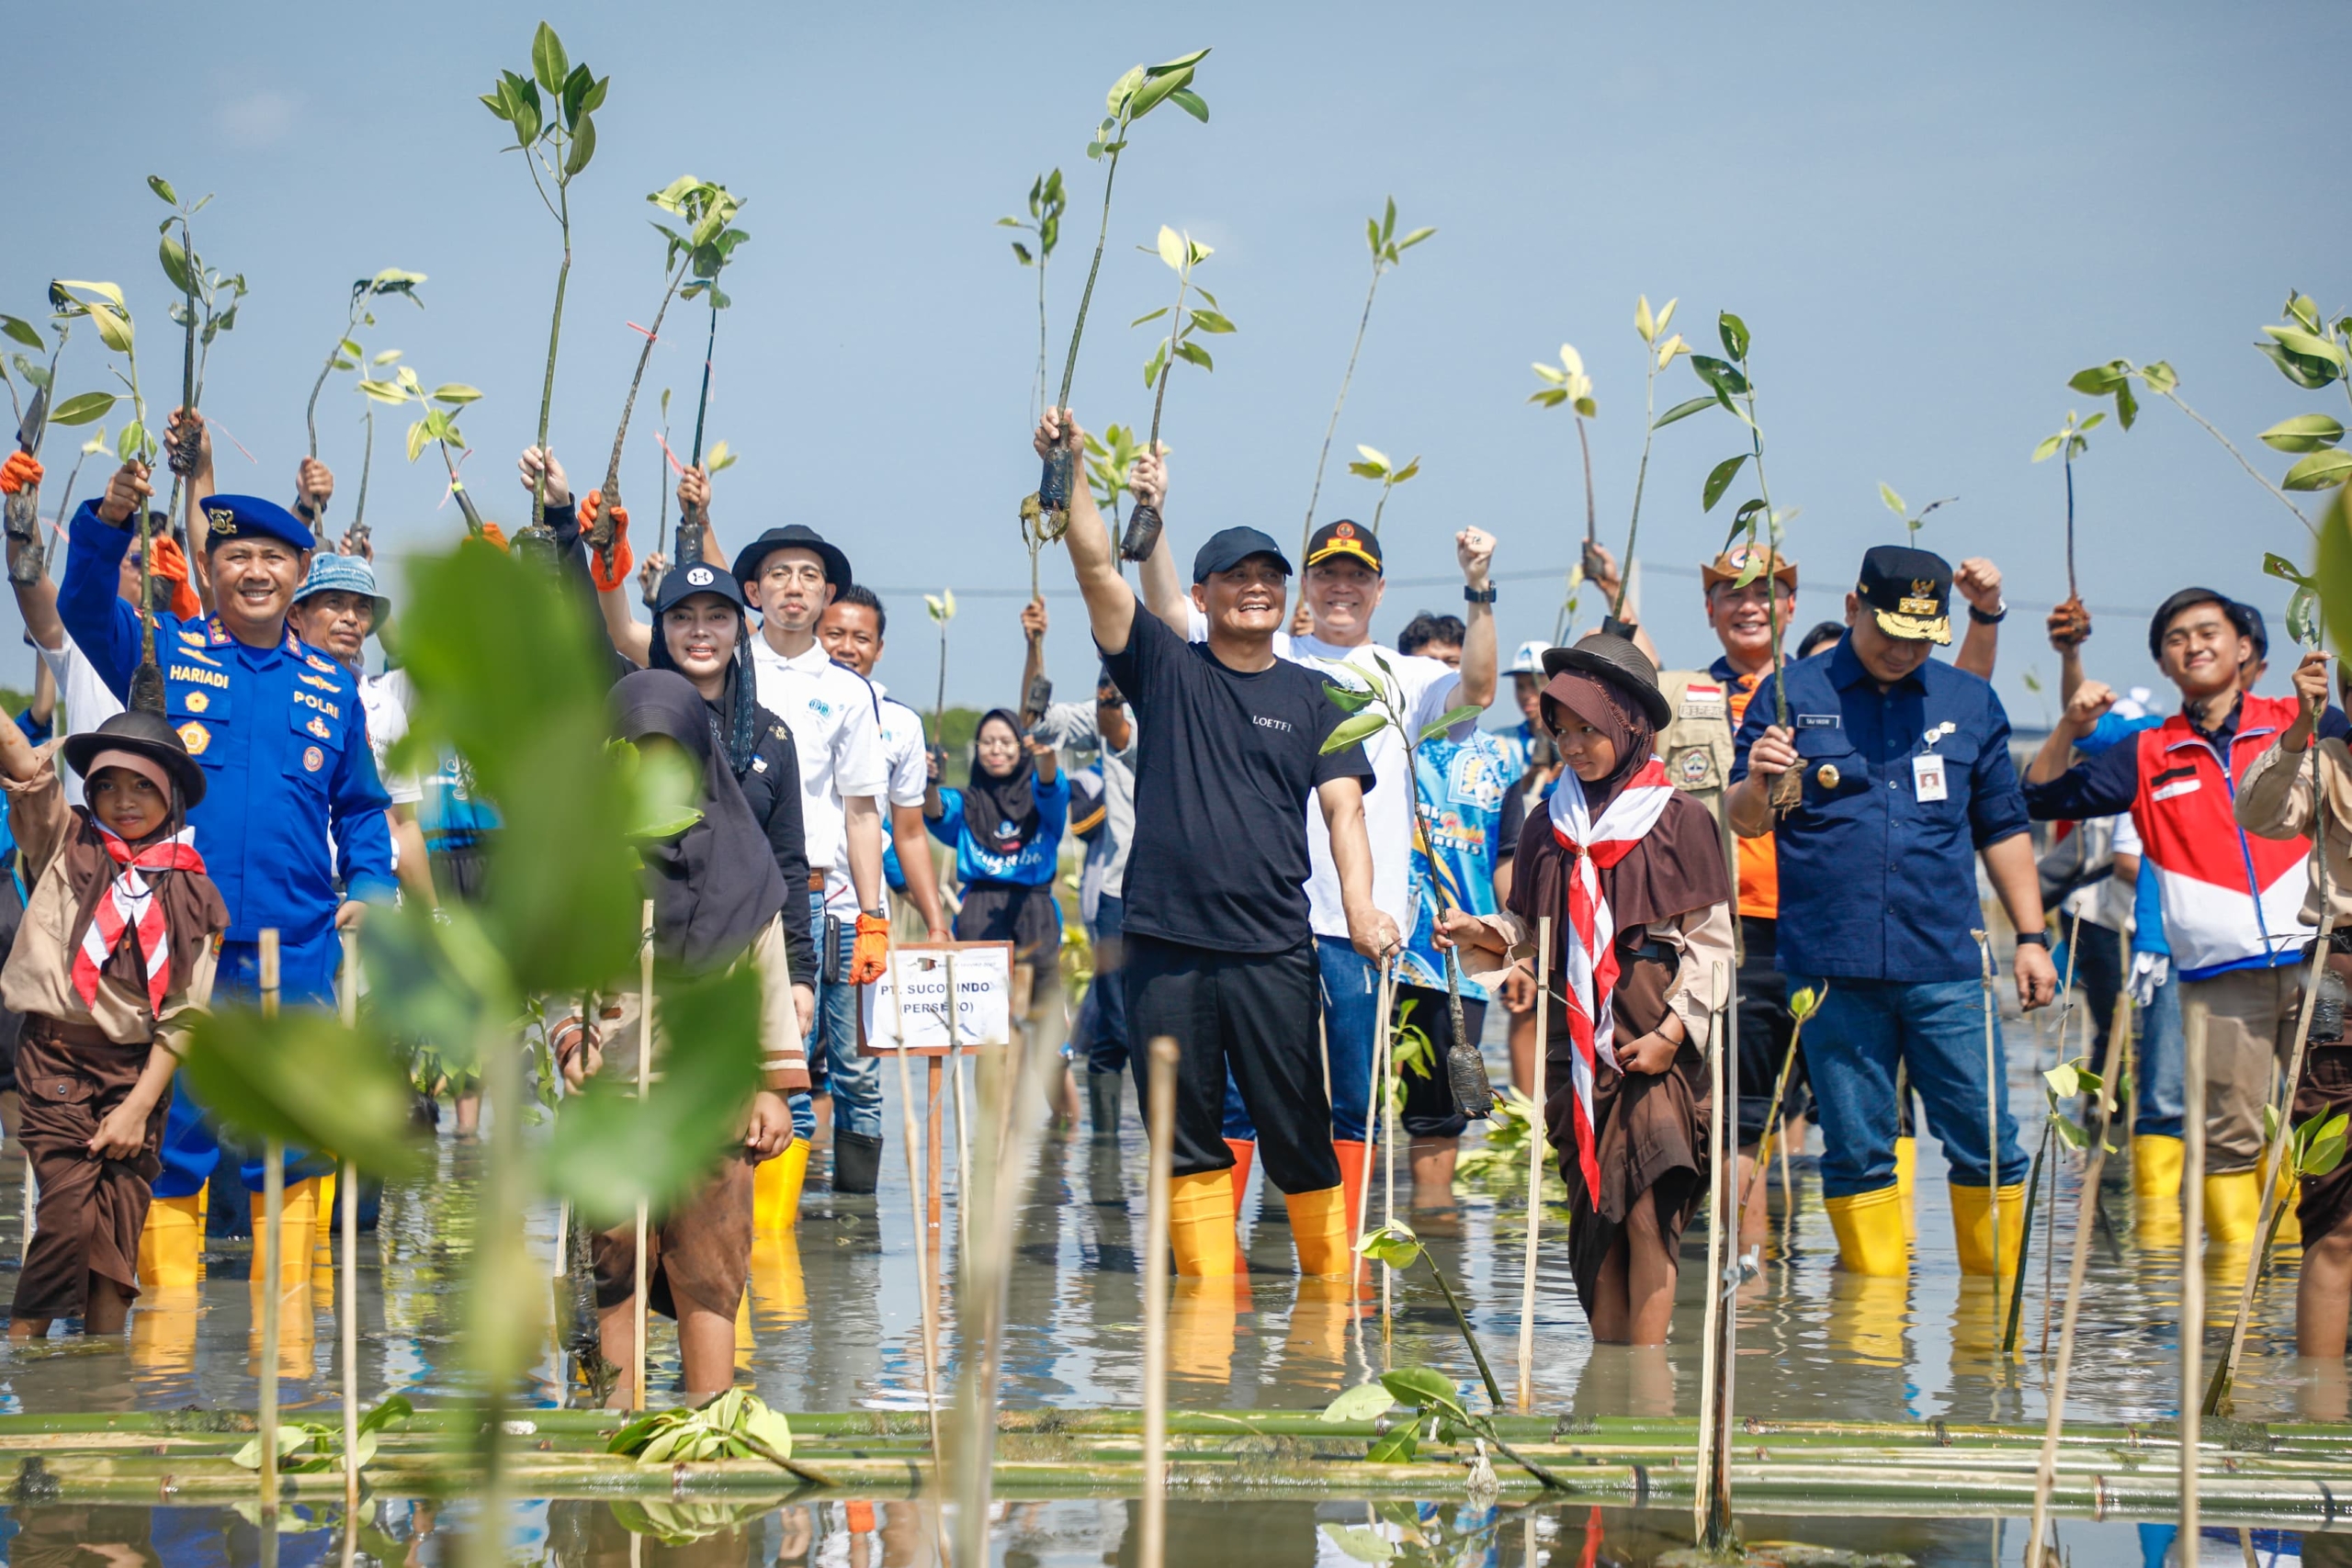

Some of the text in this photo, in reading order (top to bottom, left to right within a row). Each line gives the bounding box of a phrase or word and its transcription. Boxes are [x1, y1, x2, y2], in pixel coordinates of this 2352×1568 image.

[170, 664, 230, 689] HARIADI
[294, 690, 339, 719] POLRI
[1252, 715, 1292, 733] LOETFI
[908, 982, 989, 995] SUCOINDO
[899, 1001, 974, 1016] (PERSEO)
